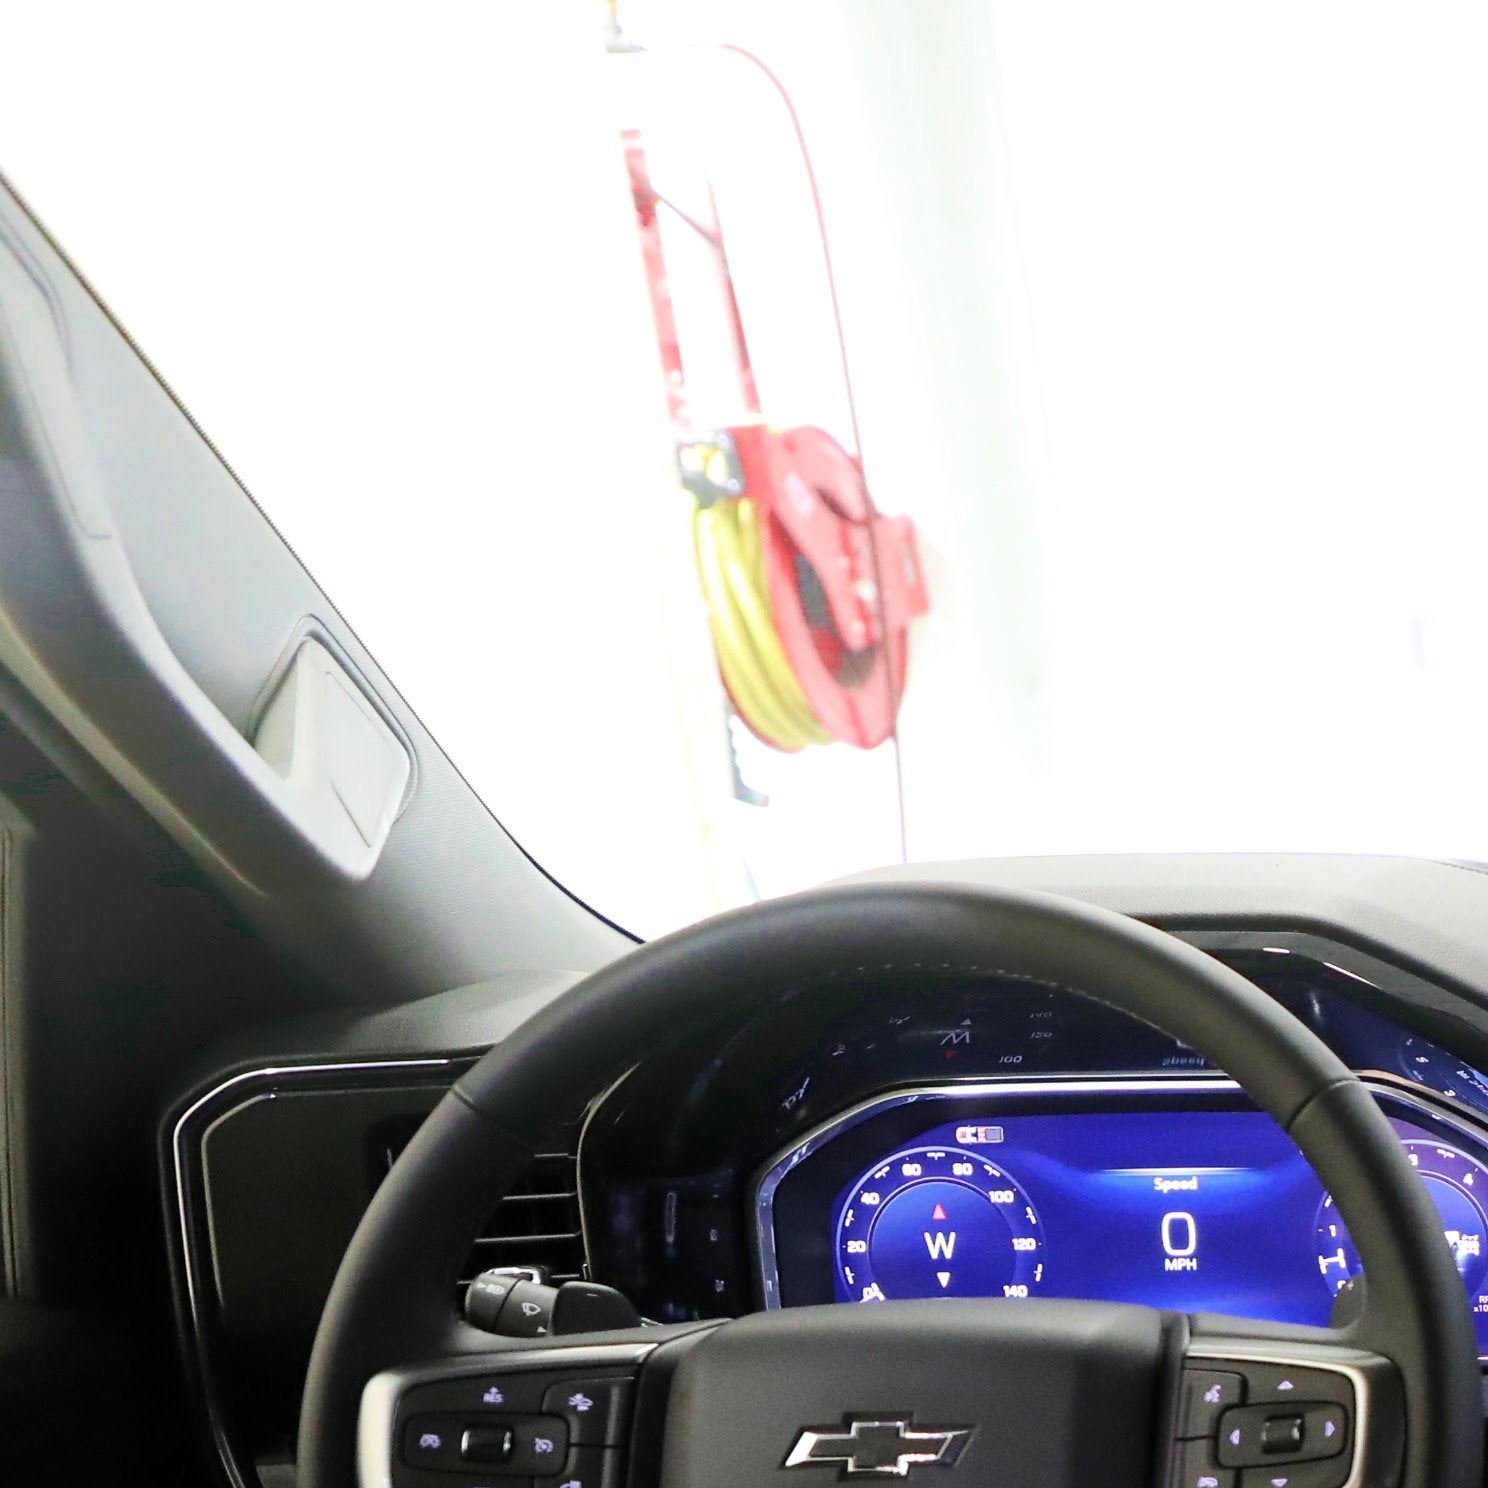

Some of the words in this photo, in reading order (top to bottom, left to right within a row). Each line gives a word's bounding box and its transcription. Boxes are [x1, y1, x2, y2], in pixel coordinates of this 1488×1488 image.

[952, 1162, 974, 1176] 80
[1153, 1176, 1198, 1193] Speed
[860, 1192, 880, 1205] 40
[988, 1190, 1015, 1204] 100
[1161, 1211, 1197, 1257] 0
[846, 1240, 867, 1253] 20
[923, 1231, 957, 1260] W
[1012, 1237, 1037, 1251] 120
[1164, 1257, 1198, 1271] MPH
[1002, 1285, 1029, 1298] 140
